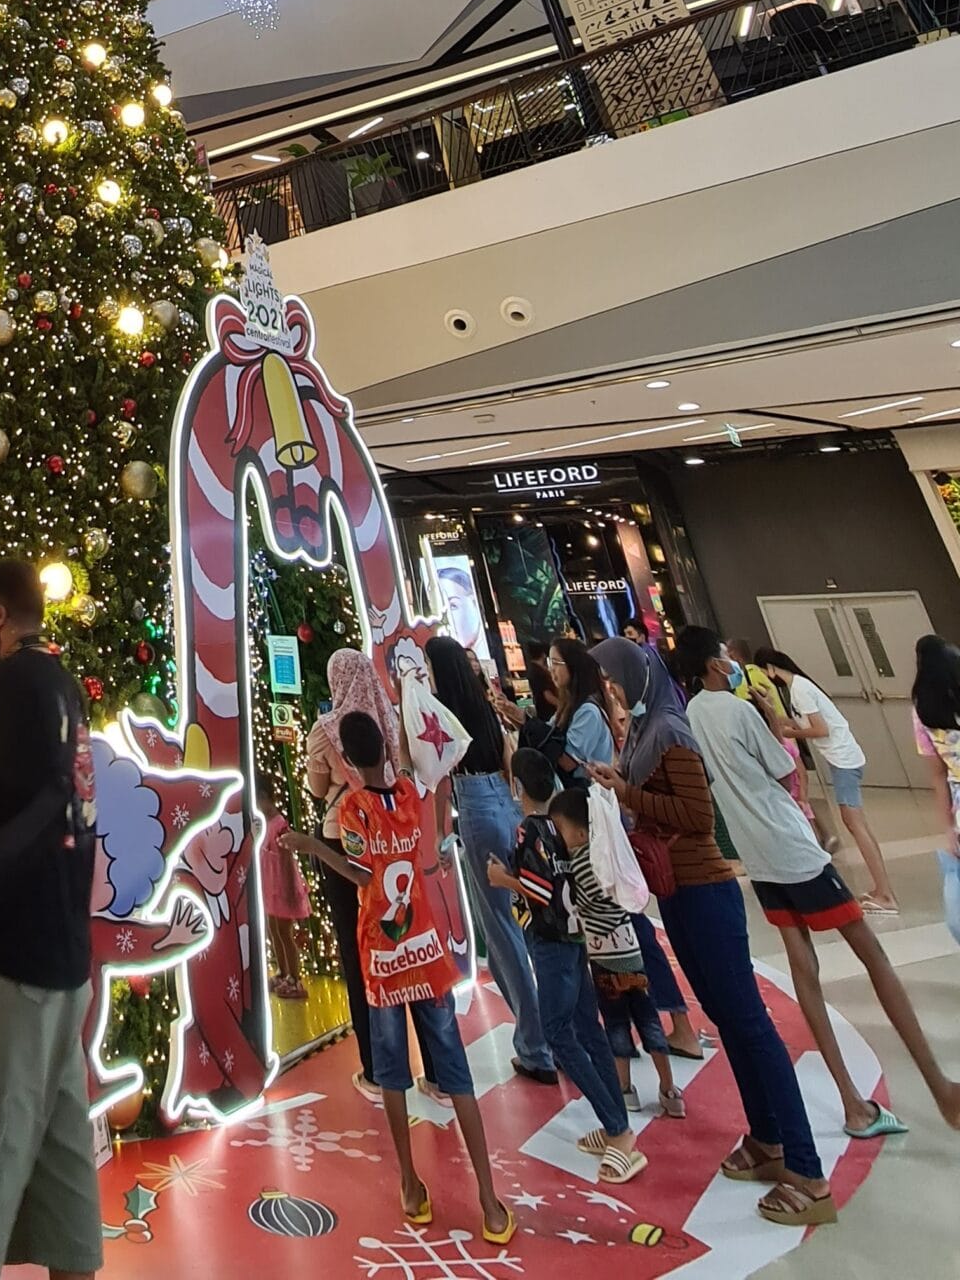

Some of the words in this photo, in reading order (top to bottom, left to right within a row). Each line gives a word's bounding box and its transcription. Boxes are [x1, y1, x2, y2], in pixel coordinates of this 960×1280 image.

[249, 263, 274, 279] MAGICAL
[247, 279, 281, 302] LIGHTS
[246, 300, 286, 332] 2021
[494, 465, 599, 488] LIFEFORD
[536, 490, 565, 499] PARIS
[565, 580, 626, 591] LIFEFORD
[373, 933, 442, 974] facebook
[379, 982, 436, 1008] Amazon
